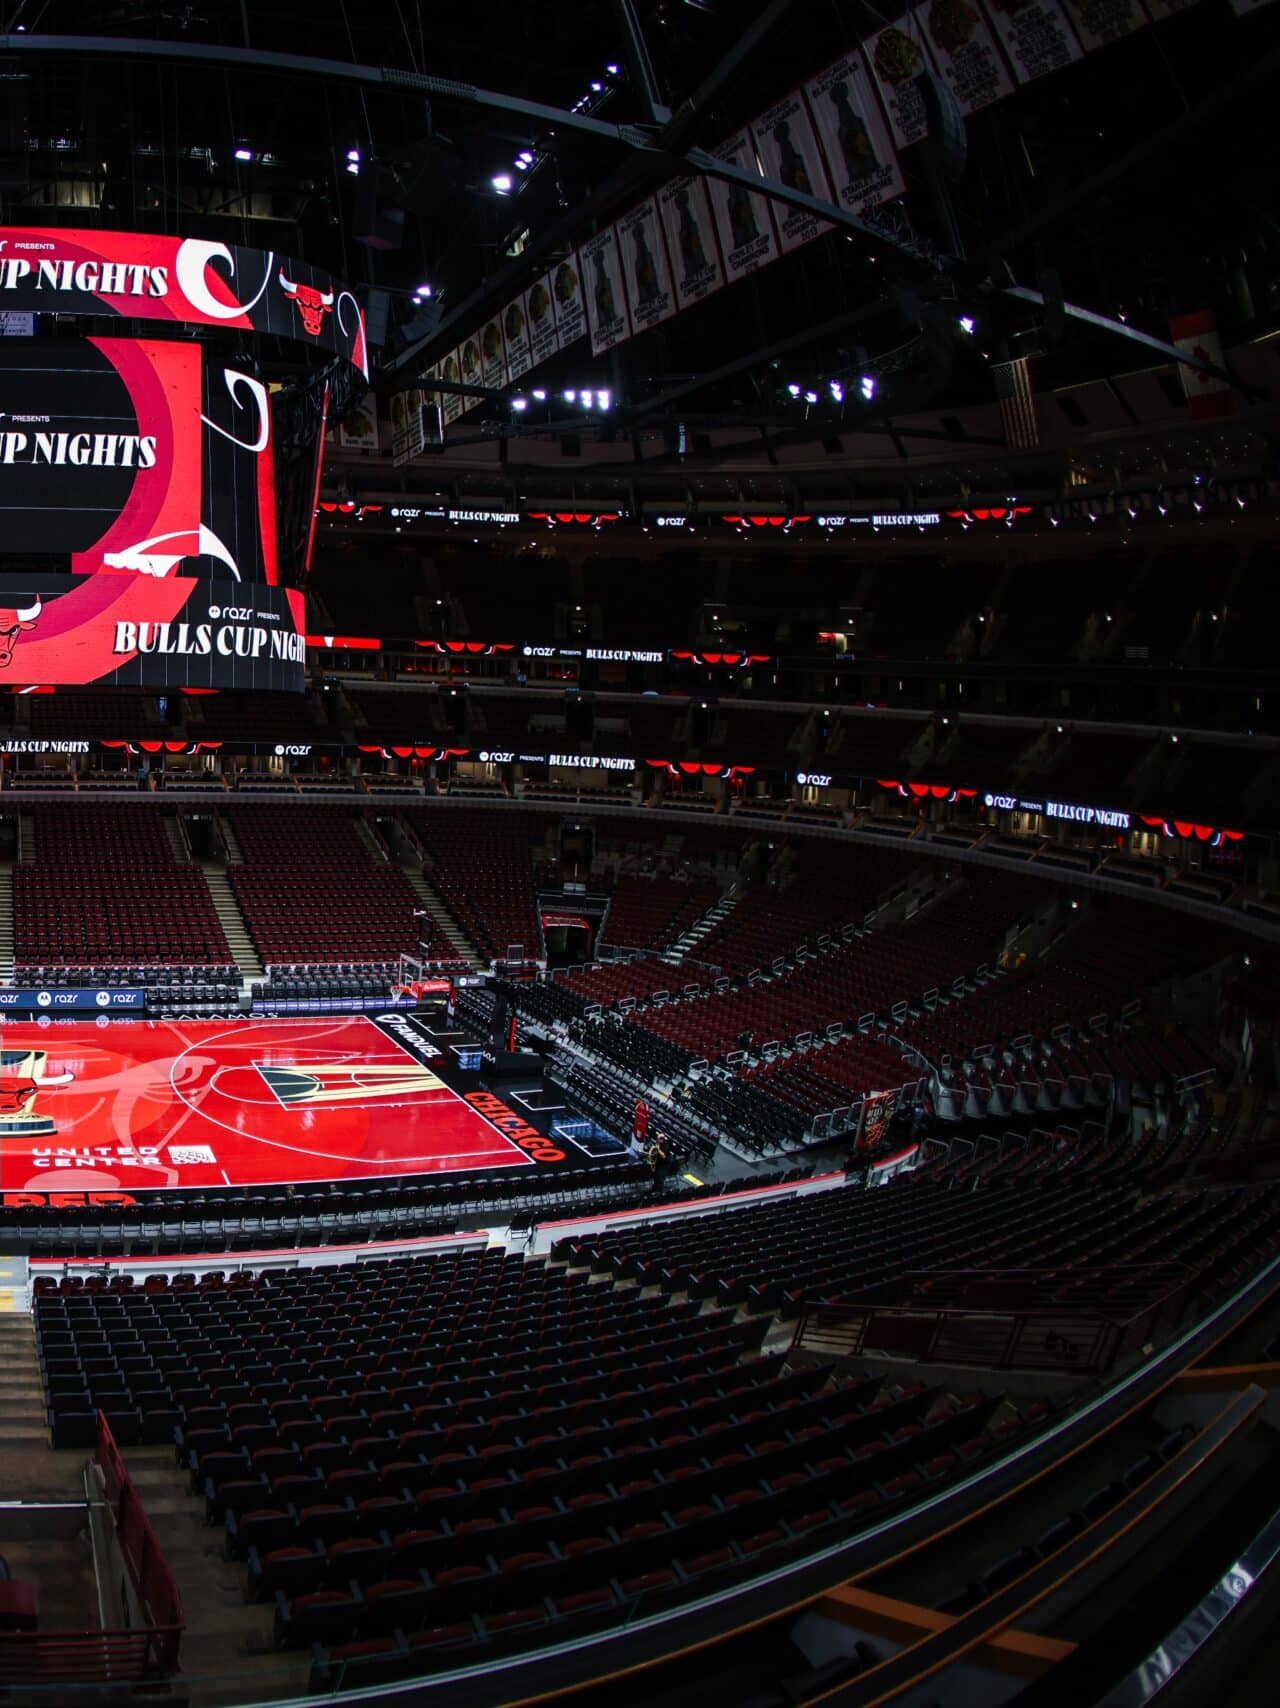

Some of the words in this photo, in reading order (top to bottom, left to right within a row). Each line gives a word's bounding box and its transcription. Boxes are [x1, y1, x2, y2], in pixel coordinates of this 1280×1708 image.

[15, 242, 55, 250] PRESENTS
[35, 260, 169, 297] NIGHTS
[12, 415, 50, 423] PRESENTS
[31, 433, 157, 469] NIGHTS
[400, 509, 420, 517] razr
[449, 511, 474, 520] BULLS
[474, 512, 490, 520] CUP
[491, 513, 519, 522] NIGHTS
[826, 517, 846, 525] razr
[873, 516, 896, 525] BULLS
[897, 516, 912, 524] CUP
[223, 607, 253, 620] razr
[257, 612, 280, 621] PRESENTS
[114, 621, 211, 655] BULLS
[216, 625, 268, 657] CUP
[533, 648, 555, 656] razr
[586, 649, 613, 659] BULLS
[614, 651, 631, 660] CUP
[632, 652, 662, 661] NIGHTS
[28, 741, 49, 752] CUP
[50, 742, 89, 752] NIGHTS
[286, 746, 311, 755] razr
[490, 753, 514, 762] razr
[549, 755, 578, 766] BULLS
[580, 757, 599, 767] CUP
[601, 758, 635, 769] NIGHTS
[807, 775, 831, 785] razr
[992, 796, 1016, 808] razr
[1047, 803, 1075, 818] BULLS
[1076, 807, 1094, 821] CUP
[1095, 810, 1129, 827] NIGHTS
[55, 994, 78, 1003] razr
[113, 994, 136, 1003] razr
[160, 1012, 278, 1021] CALAMOS
[389, 1024, 443, 1058] FANDUEL
[463, 1091, 566, 1162] CHICAGO
[32, 1147, 159, 1157] UNITED
[33, 1157, 162, 1168] CENTER
